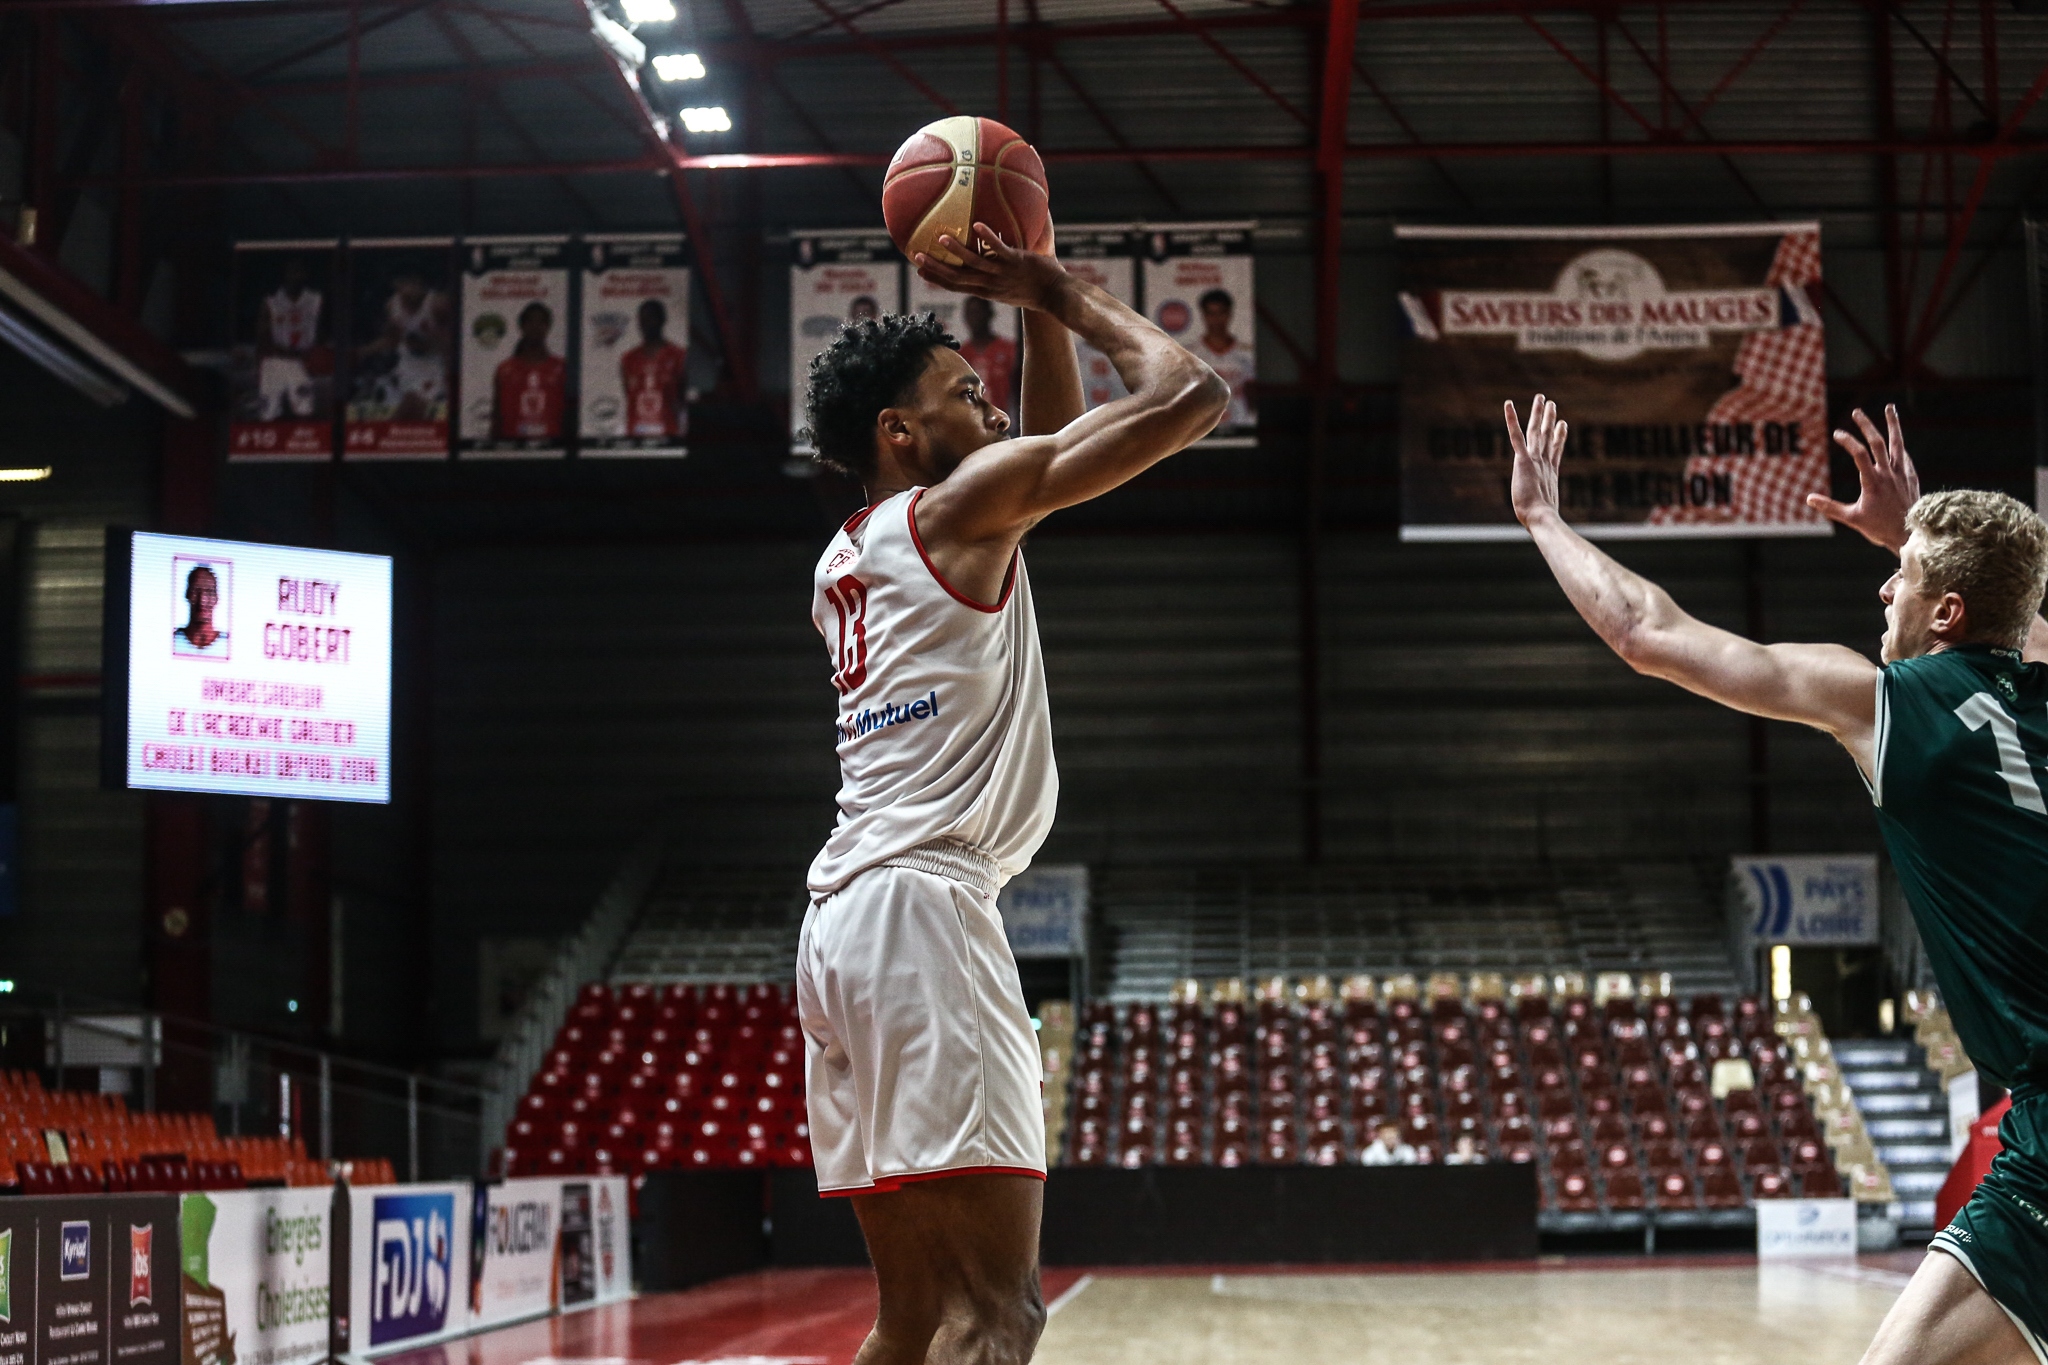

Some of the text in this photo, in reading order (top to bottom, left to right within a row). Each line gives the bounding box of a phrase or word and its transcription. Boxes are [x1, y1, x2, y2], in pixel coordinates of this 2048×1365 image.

[1451, 297, 1772, 326] SAVEURS DES MAUGES
[1604, 423, 1753, 456] MEILLEUR
[1764, 420, 1802, 454] DE
[278, 576, 340, 616] RUDY
[263, 622, 351, 664] GOBERT
[824, 574, 868, 696] 13
[857, 691, 938, 739] Mutuel
[1953, 692, 2048, 815] 1
[64, 1237, 87, 1265] Kyriad
[374, 1218, 425, 1322] FDJ
